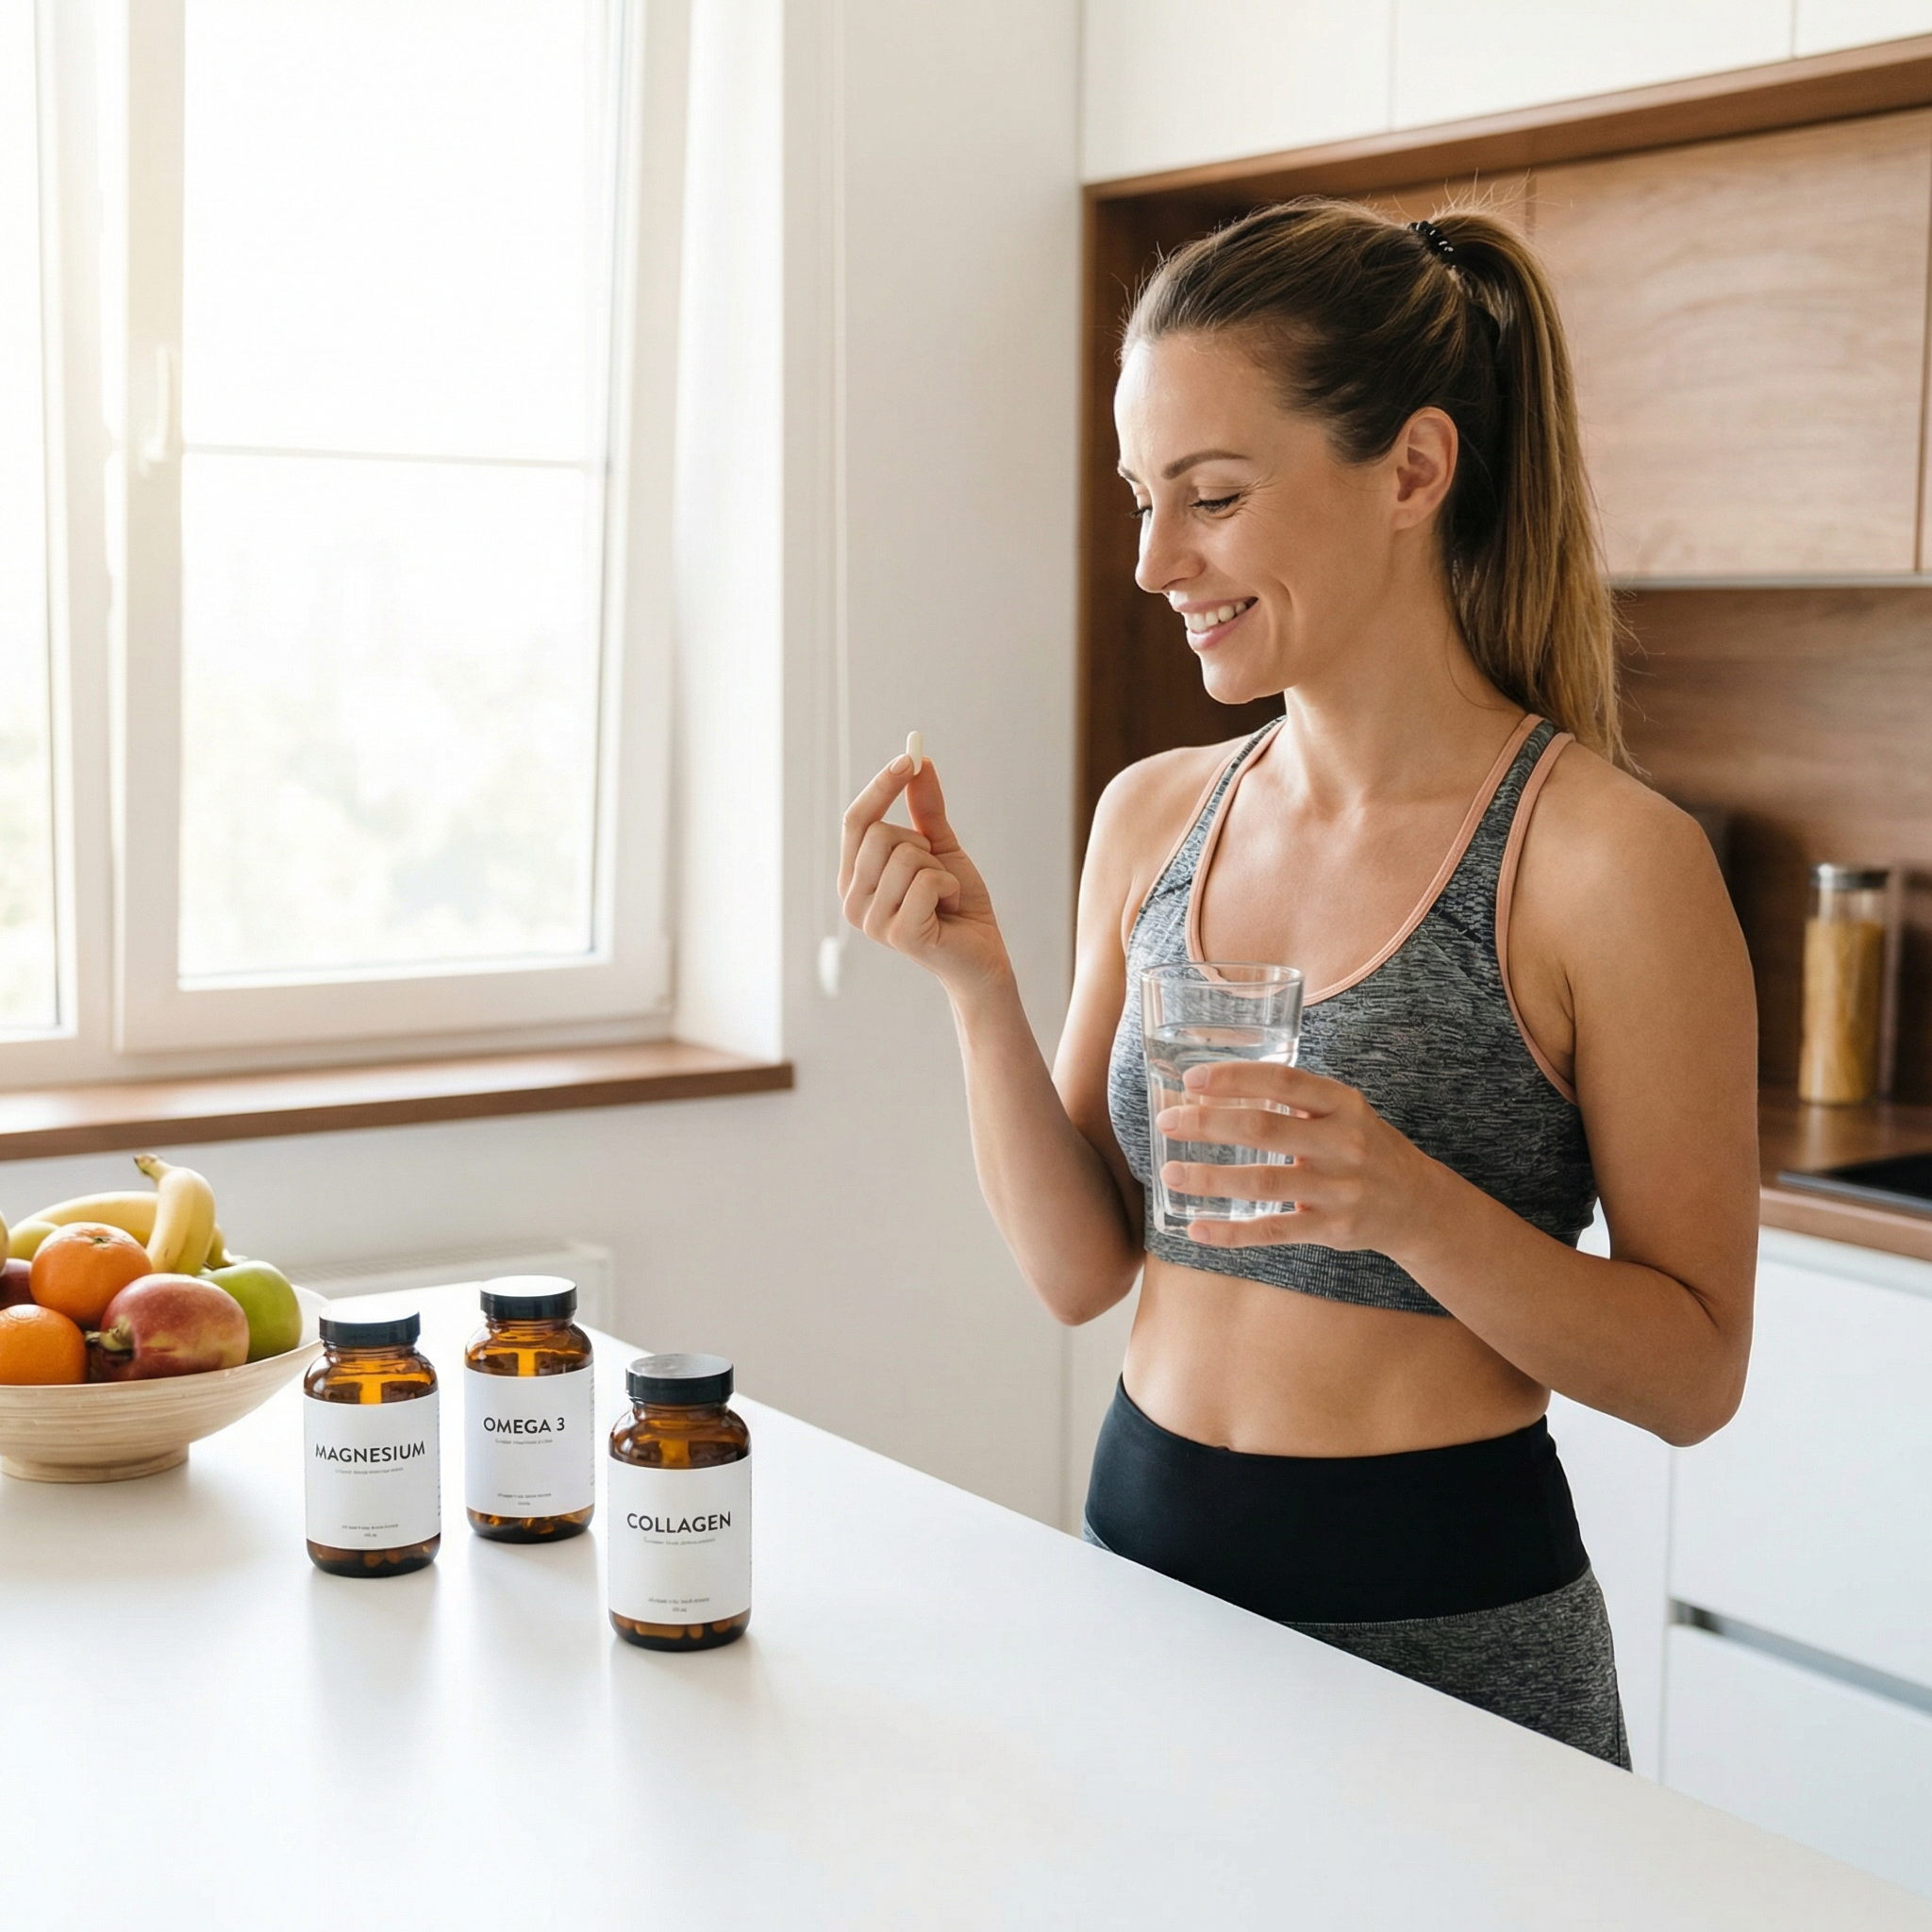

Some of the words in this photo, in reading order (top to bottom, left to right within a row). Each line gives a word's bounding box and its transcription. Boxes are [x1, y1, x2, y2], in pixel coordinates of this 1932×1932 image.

[483, 1416, 552, 1435] OMEGA
[556, 1416, 565, 1432] 3
[315, 1441, 425, 1463] MAGNESIUM
[626, 1510, 731, 1534] COLLAGEN
